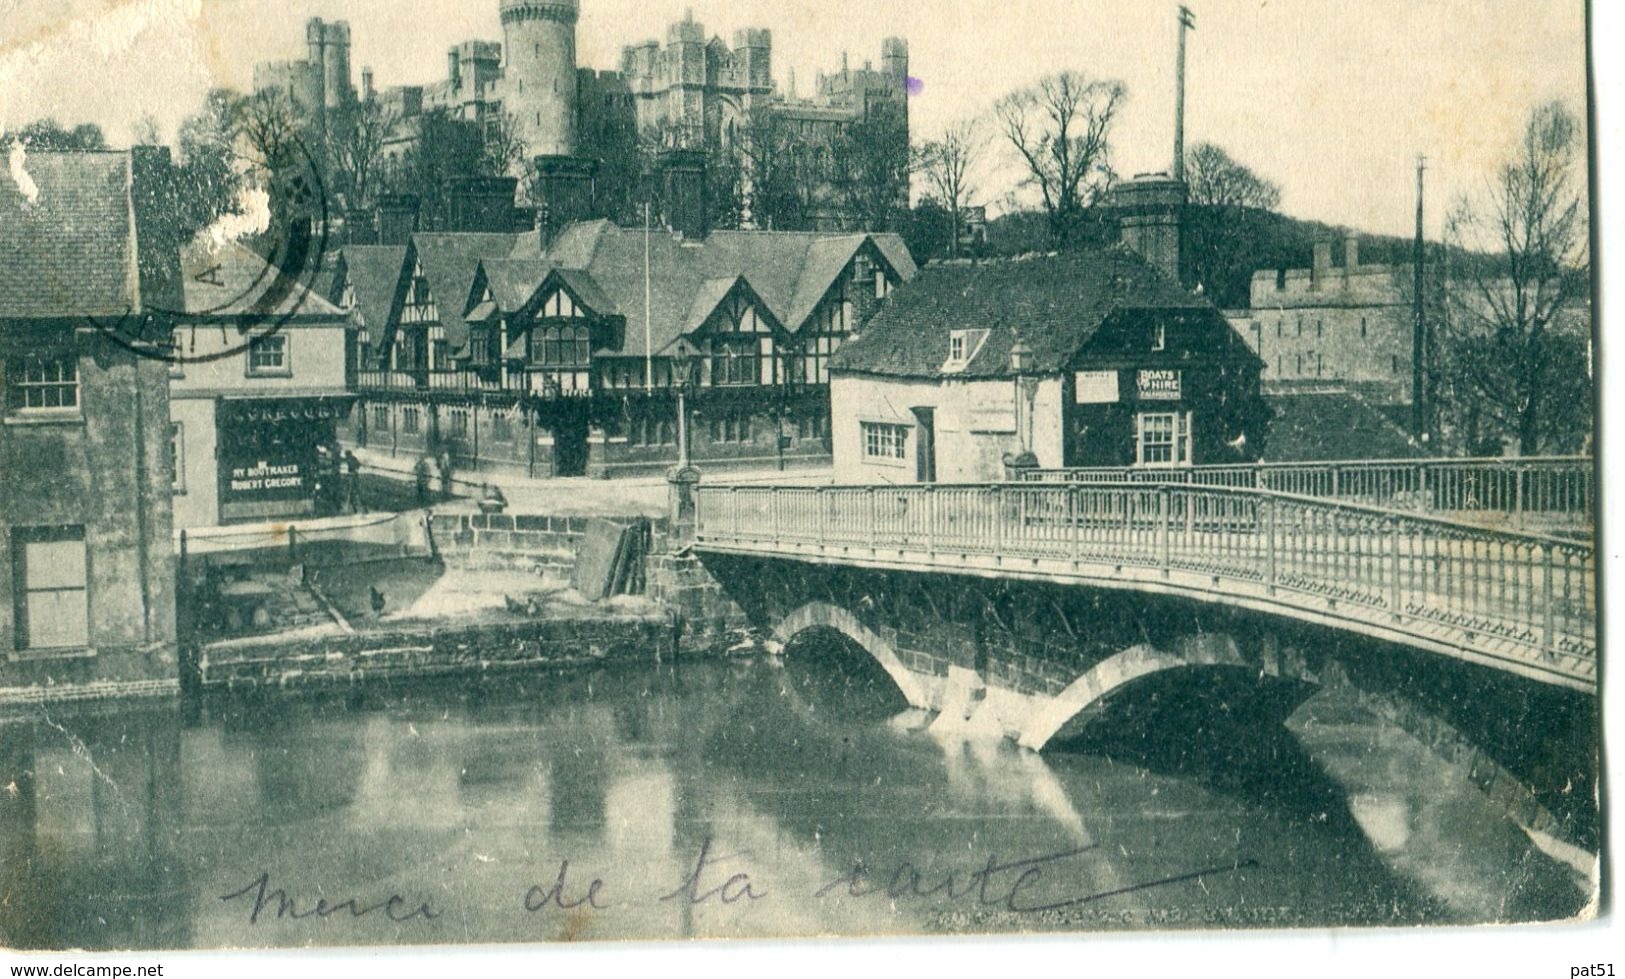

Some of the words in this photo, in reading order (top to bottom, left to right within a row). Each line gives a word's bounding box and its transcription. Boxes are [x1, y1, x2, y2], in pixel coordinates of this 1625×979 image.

[1141, 370, 1174, 381] BOATS
[1151, 380, 1178, 390] HIRE
[264, 477, 301, 488] GREGORY
[524, 859, 606, 910] de
